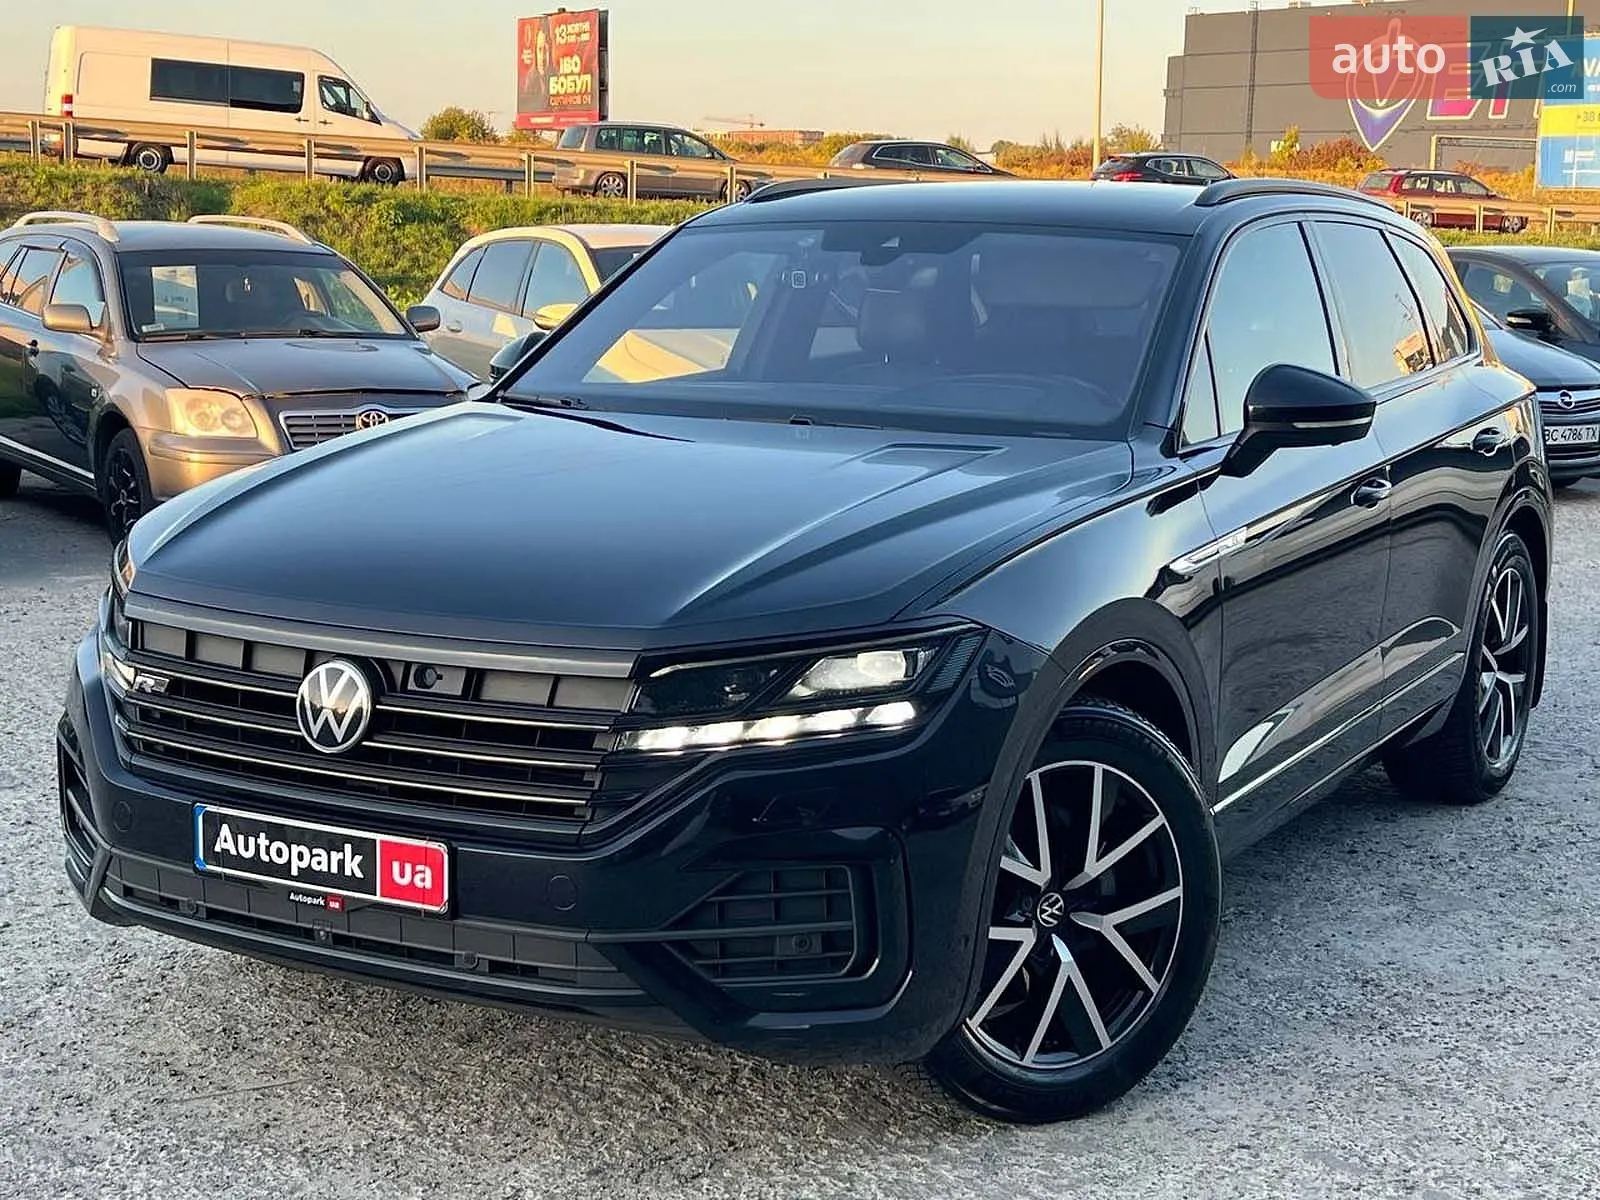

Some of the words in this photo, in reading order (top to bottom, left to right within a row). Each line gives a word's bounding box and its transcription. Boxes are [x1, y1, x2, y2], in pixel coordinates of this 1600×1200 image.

[549, 74, 592, 96] БОБУЛ
[214, 823, 364, 879] Autopark
[391, 859, 433, 890] ua
[289, 891, 325, 907] Autopark
[329, 899, 341, 910] ua
